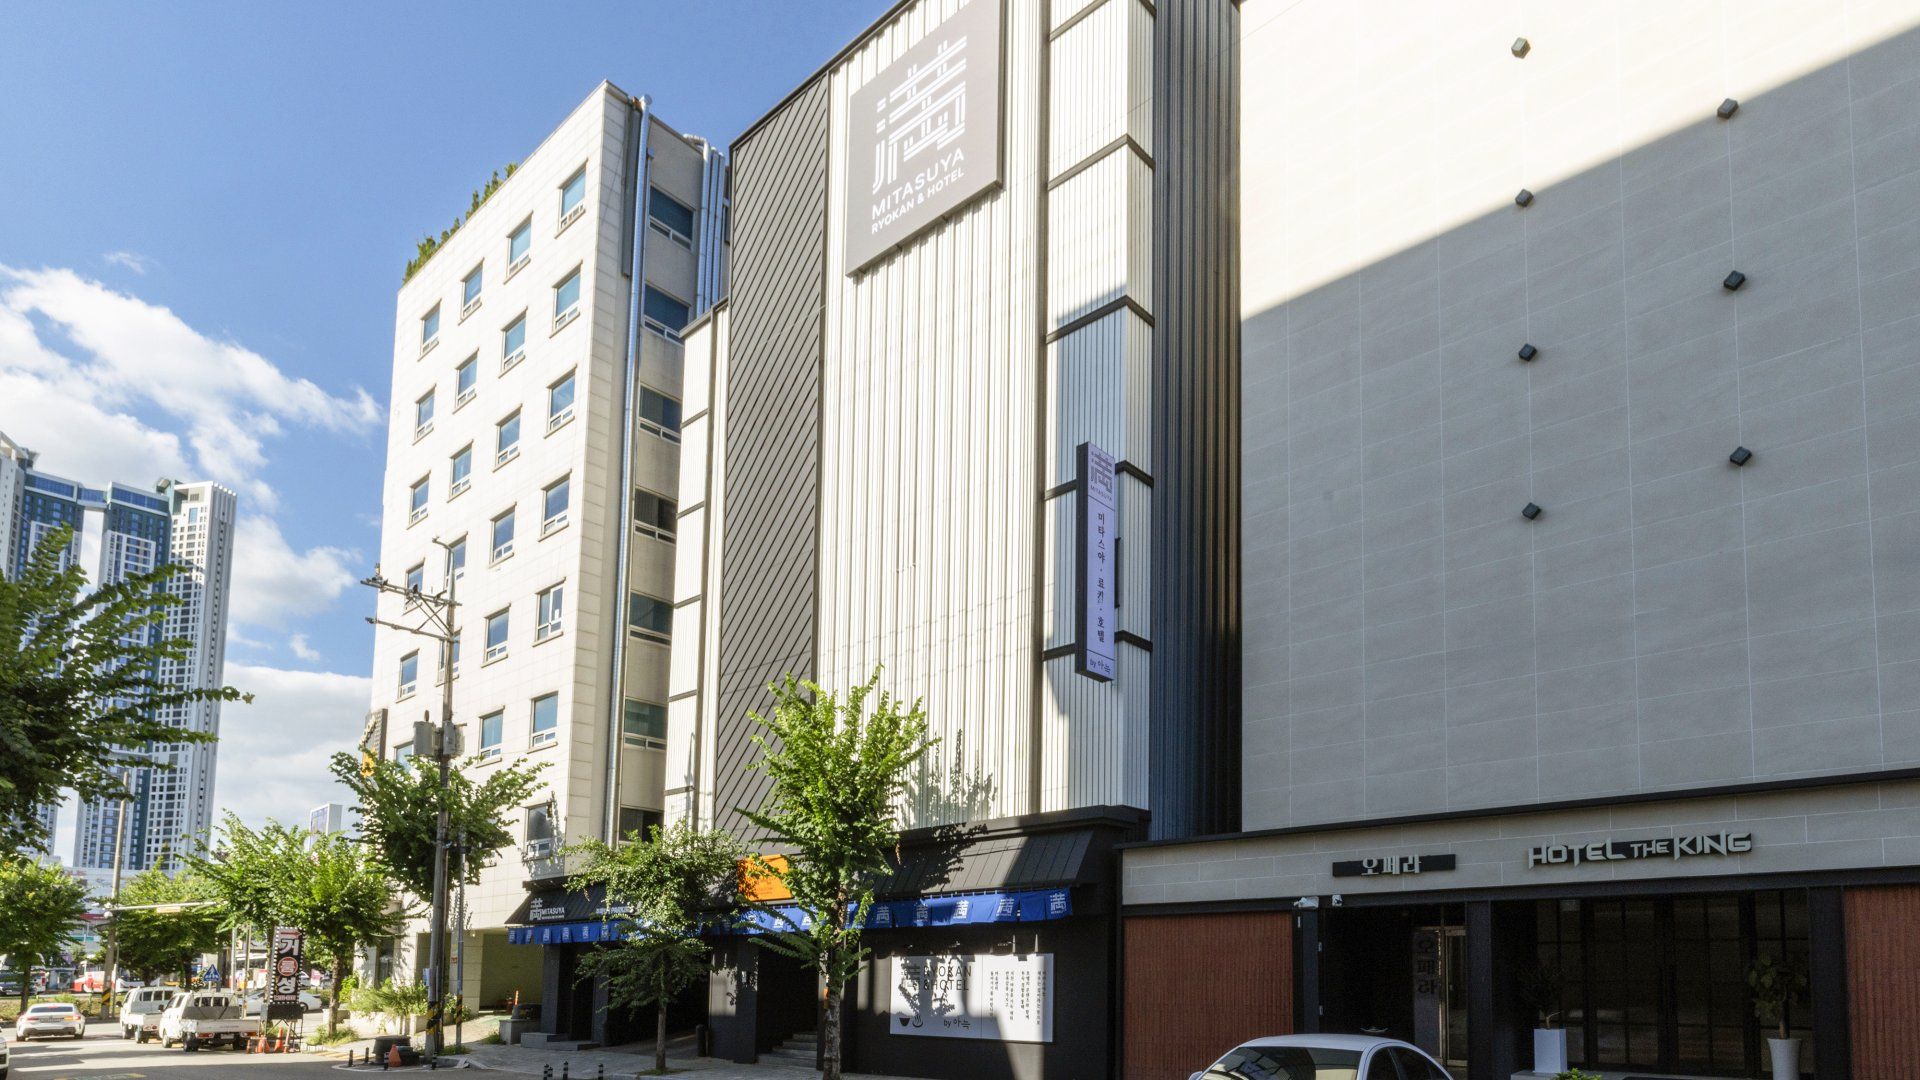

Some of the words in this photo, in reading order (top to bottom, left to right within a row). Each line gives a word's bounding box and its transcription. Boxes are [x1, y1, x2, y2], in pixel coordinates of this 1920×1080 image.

[872, 147, 964, 220] MITASUYA
[871, 197, 915, 235] RYOKAN
[917, 192, 925, 205] &
[927, 167, 965, 199] HOTEL
[1097, 512, 1105, 564] 미타스야
[1097, 616, 1105, 643] 호텔
[1361, 854, 1422, 876] 오페라
[1528, 837, 1627, 869] HOTEL
[1630, 839, 1670, 858] THE
[1673, 829, 1752, 861] KING
[923, 966, 972, 978] RYOKAN
[944, 1019, 952, 1028] by
[953, 1018, 971, 1030] 아늑
